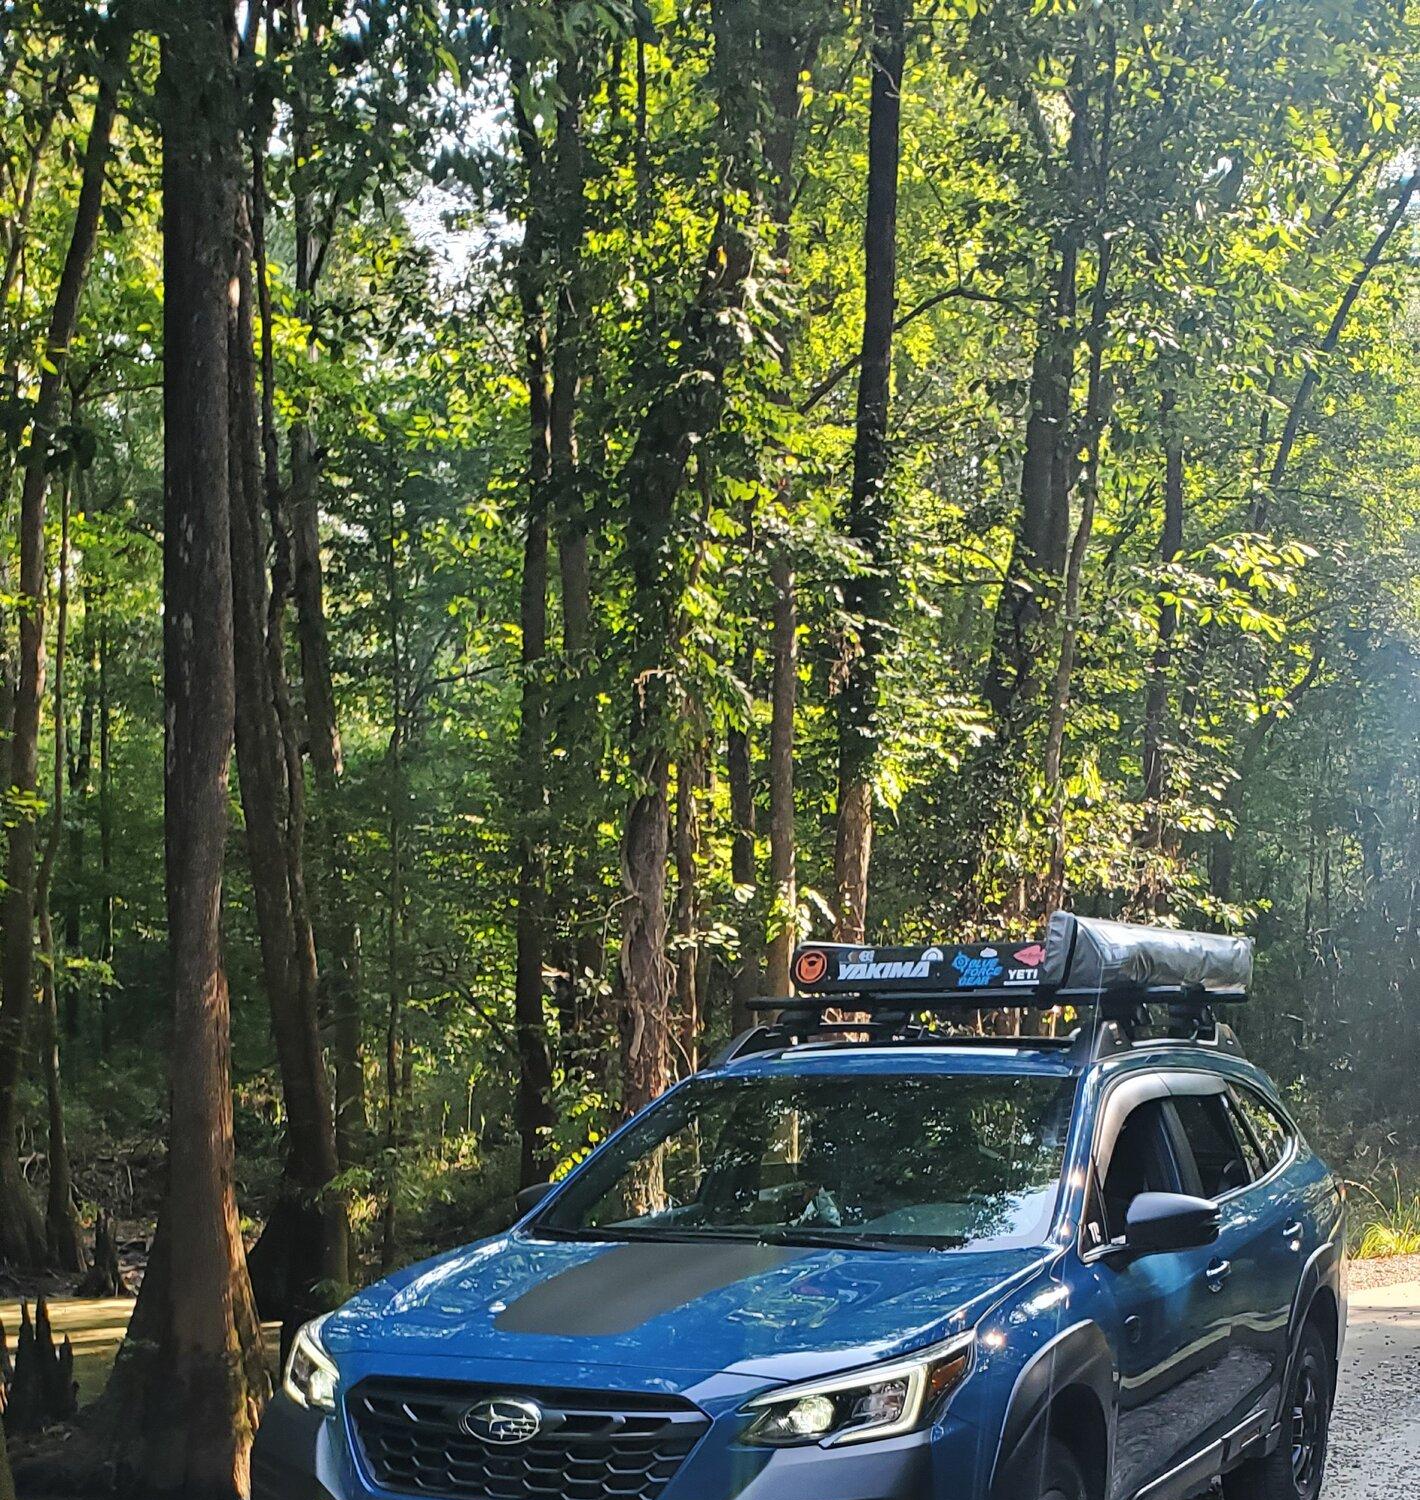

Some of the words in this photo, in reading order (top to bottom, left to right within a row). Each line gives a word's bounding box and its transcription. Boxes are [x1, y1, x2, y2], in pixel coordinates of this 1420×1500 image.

[969, 958, 999, 967] BLUE
[837, 961, 930, 980] YAKIMA
[1008, 968, 1038, 980] YETI
[958, 976, 990, 986] GEAR
